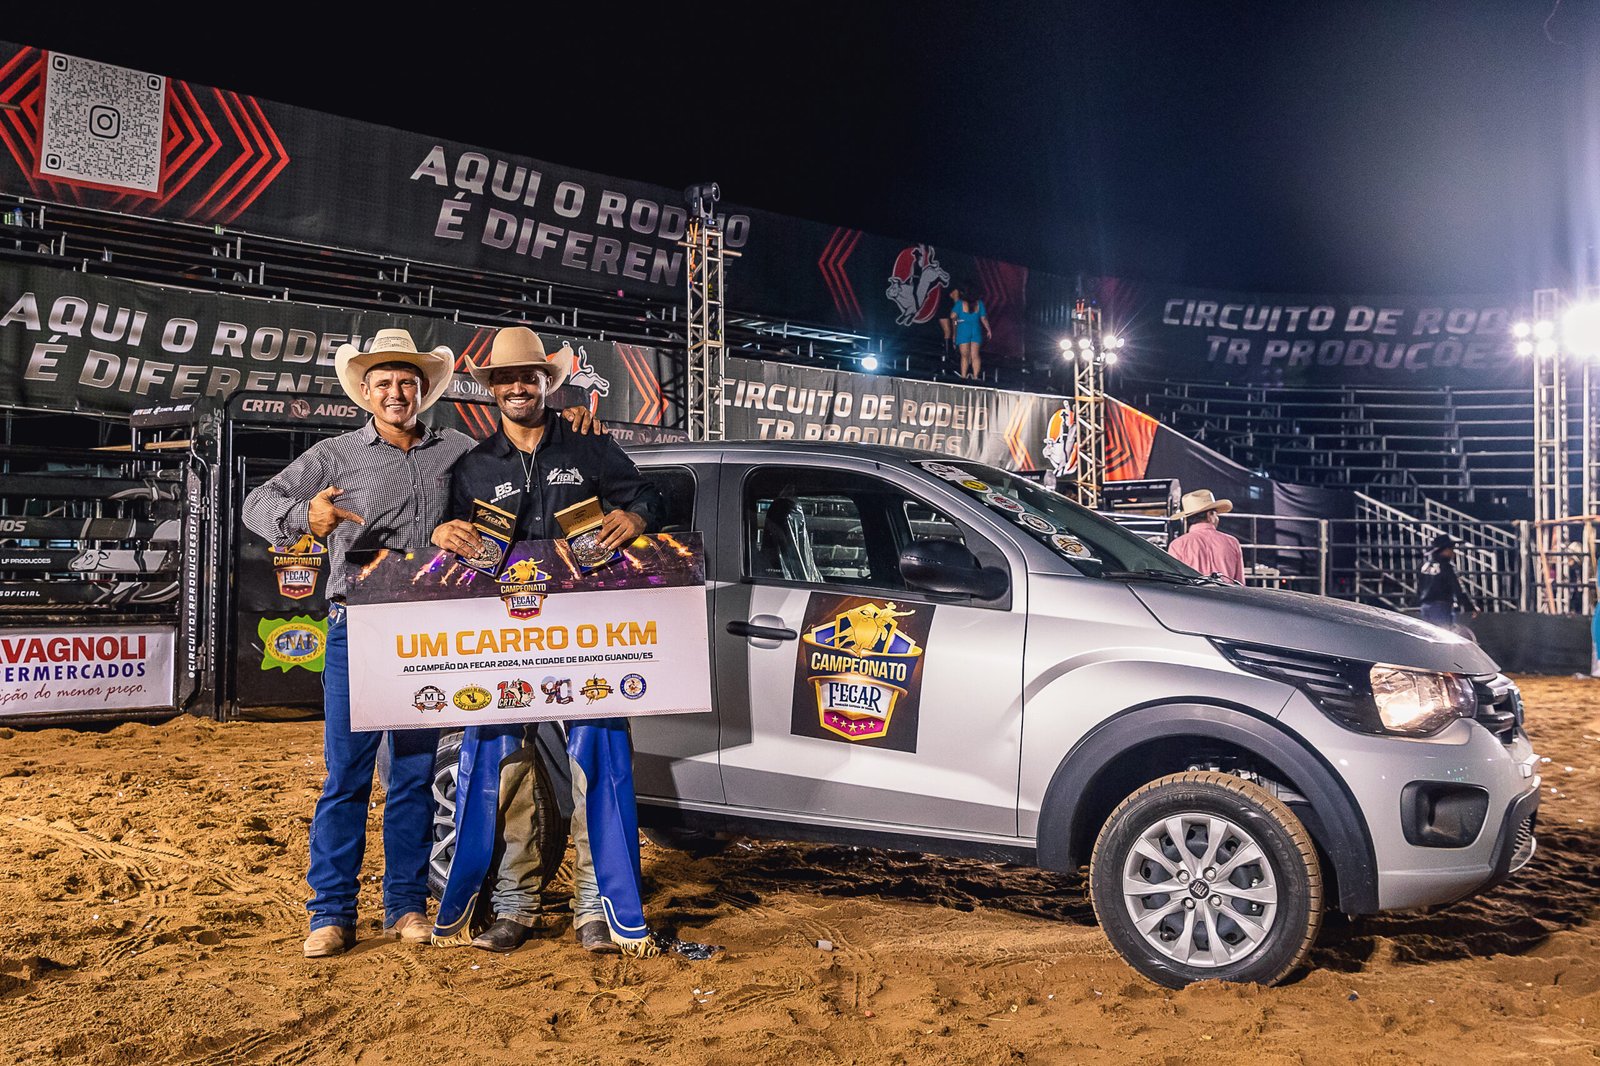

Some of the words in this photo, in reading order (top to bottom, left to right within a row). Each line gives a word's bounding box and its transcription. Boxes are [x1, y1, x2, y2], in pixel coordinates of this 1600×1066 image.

[409, 145, 542, 207] AQUI
[553, 181, 586, 219] O
[434, 191, 471, 240] É
[0, 292, 148, 346] AQUI
[161, 317, 198, 353] O
[1163, 299, 1335, 332] CIRCUITO
[1344, 305, 1404, 336] DE
[24, 334, 68, 381] É
[1206, 335, 1250, 365] TR
[242, 399, 285, 413] CRTR
[314, 404, 359, 418] ANOS
[714, 378, 854, 418] CIRCUITO
[859, 393, 895, 421] DE
[900, 399, 988, 431] RODEIO
[608, 428, 634, 441] RTR
[494, 481, 513, 498] BS
[273, 556, 322, 567] CAMPEONATO
[283, 570, 311, 584] FECAR
[500, 583, 547, 594] CAMPEONATO
[510, 596, 538, 608] FECAR
[0, 635, 146, 664] VAGNOLI
[396, 633, 448, 659] UM
[455, 625, 569, 656] CARRO
[606, 621, 658, 647] KM
[0, 662, 146, 682] ERMERCADOS
[403, 665, 414, 673] AO
[415, 661, 456, 672] CAMPEÃO
[457, 662, 468, 670] DA
[470, 661, 496, 669] FECAR
[497, 660, 521, 668] 2024,
[535, 657, 565, 666] CIDADE
[578, 654, 604, 663] BAIXO
[605, 652, 653, 661] GUANDU/ES
[811, 652, 907, 682] CAMPEONATO
[34, 683, 51, 699] do
[57, 685, 102, 698] menor
[104, 684, 147, 702] preço.
[829, 682, 882, 713] FECAR
